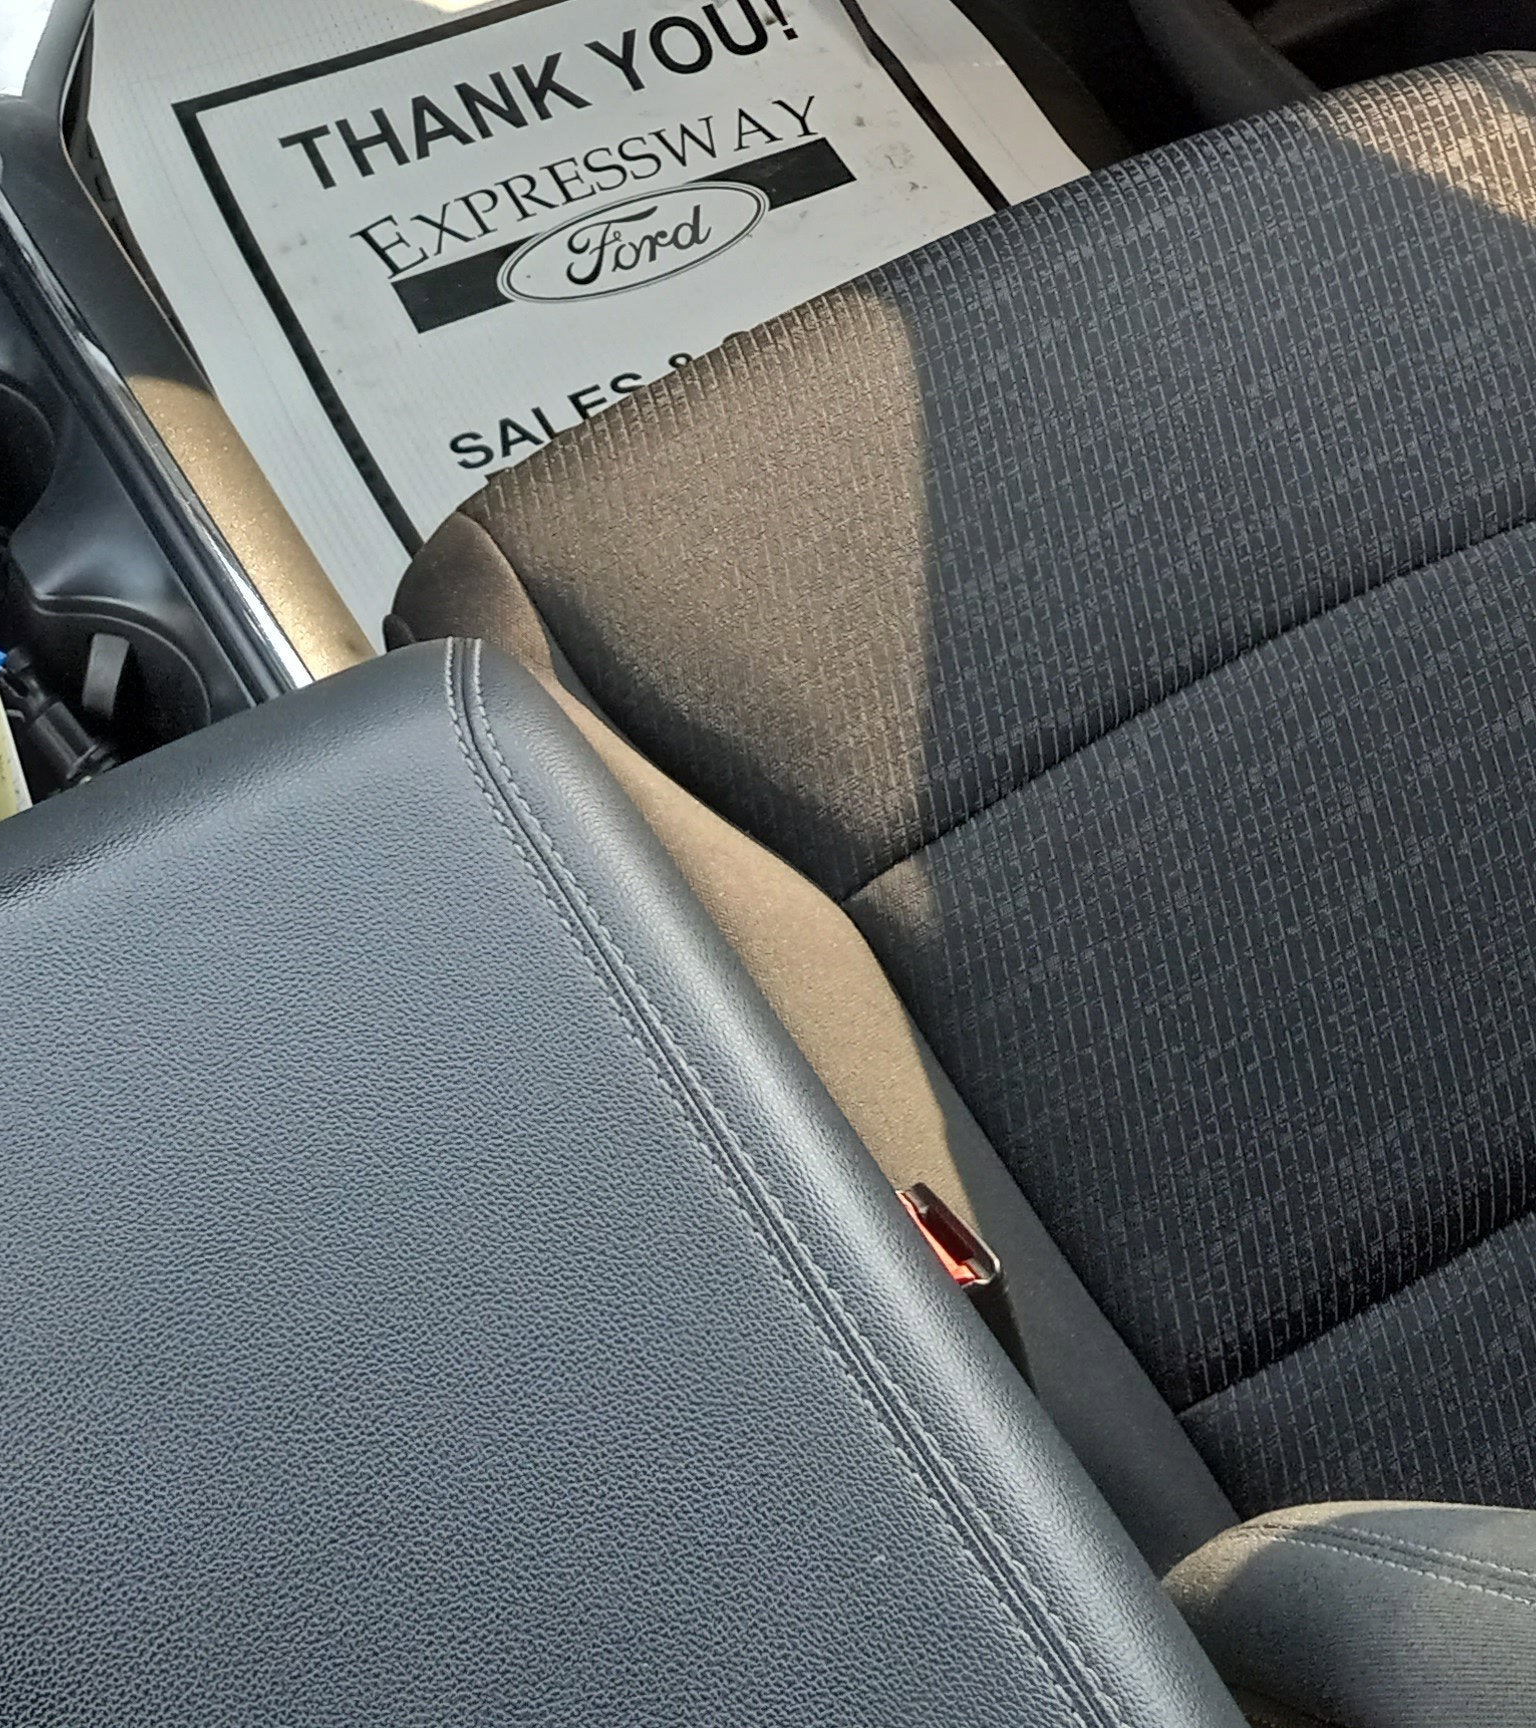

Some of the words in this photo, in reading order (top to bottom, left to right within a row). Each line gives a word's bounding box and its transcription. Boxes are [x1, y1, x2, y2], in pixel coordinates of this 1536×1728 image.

[278, 51, 590, 190] THANK
[350, 94, 820, 281] EXPRESSWAY
[564, 202, 714, 287] Ford
